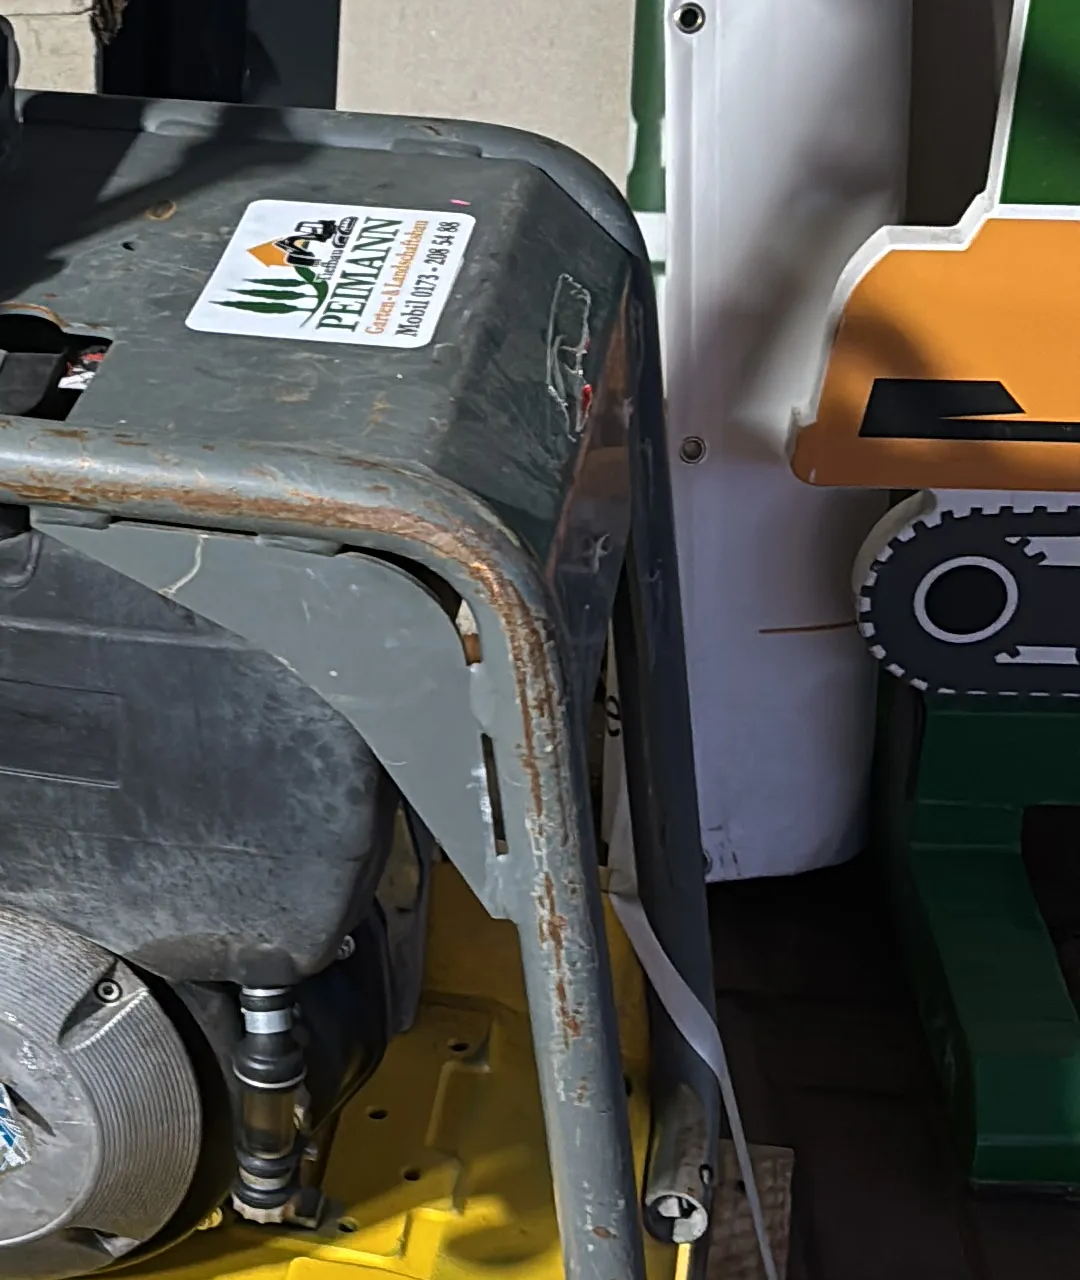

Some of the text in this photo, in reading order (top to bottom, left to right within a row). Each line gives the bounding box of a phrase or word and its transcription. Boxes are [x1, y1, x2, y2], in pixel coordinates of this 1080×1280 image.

[431, 235, 455, 246] 54
[436, 221, 461, 233] 88
[316, 249, 344, 280] Tiefbau
[384, 220, 429, 288] Landschaftsbau
[423, 248, 451, 265] 208
[315, 216, 403, 332] PEIMANN
[410, 274, 440, 298] 0173
[395, 300, 431, 337] Mobil
